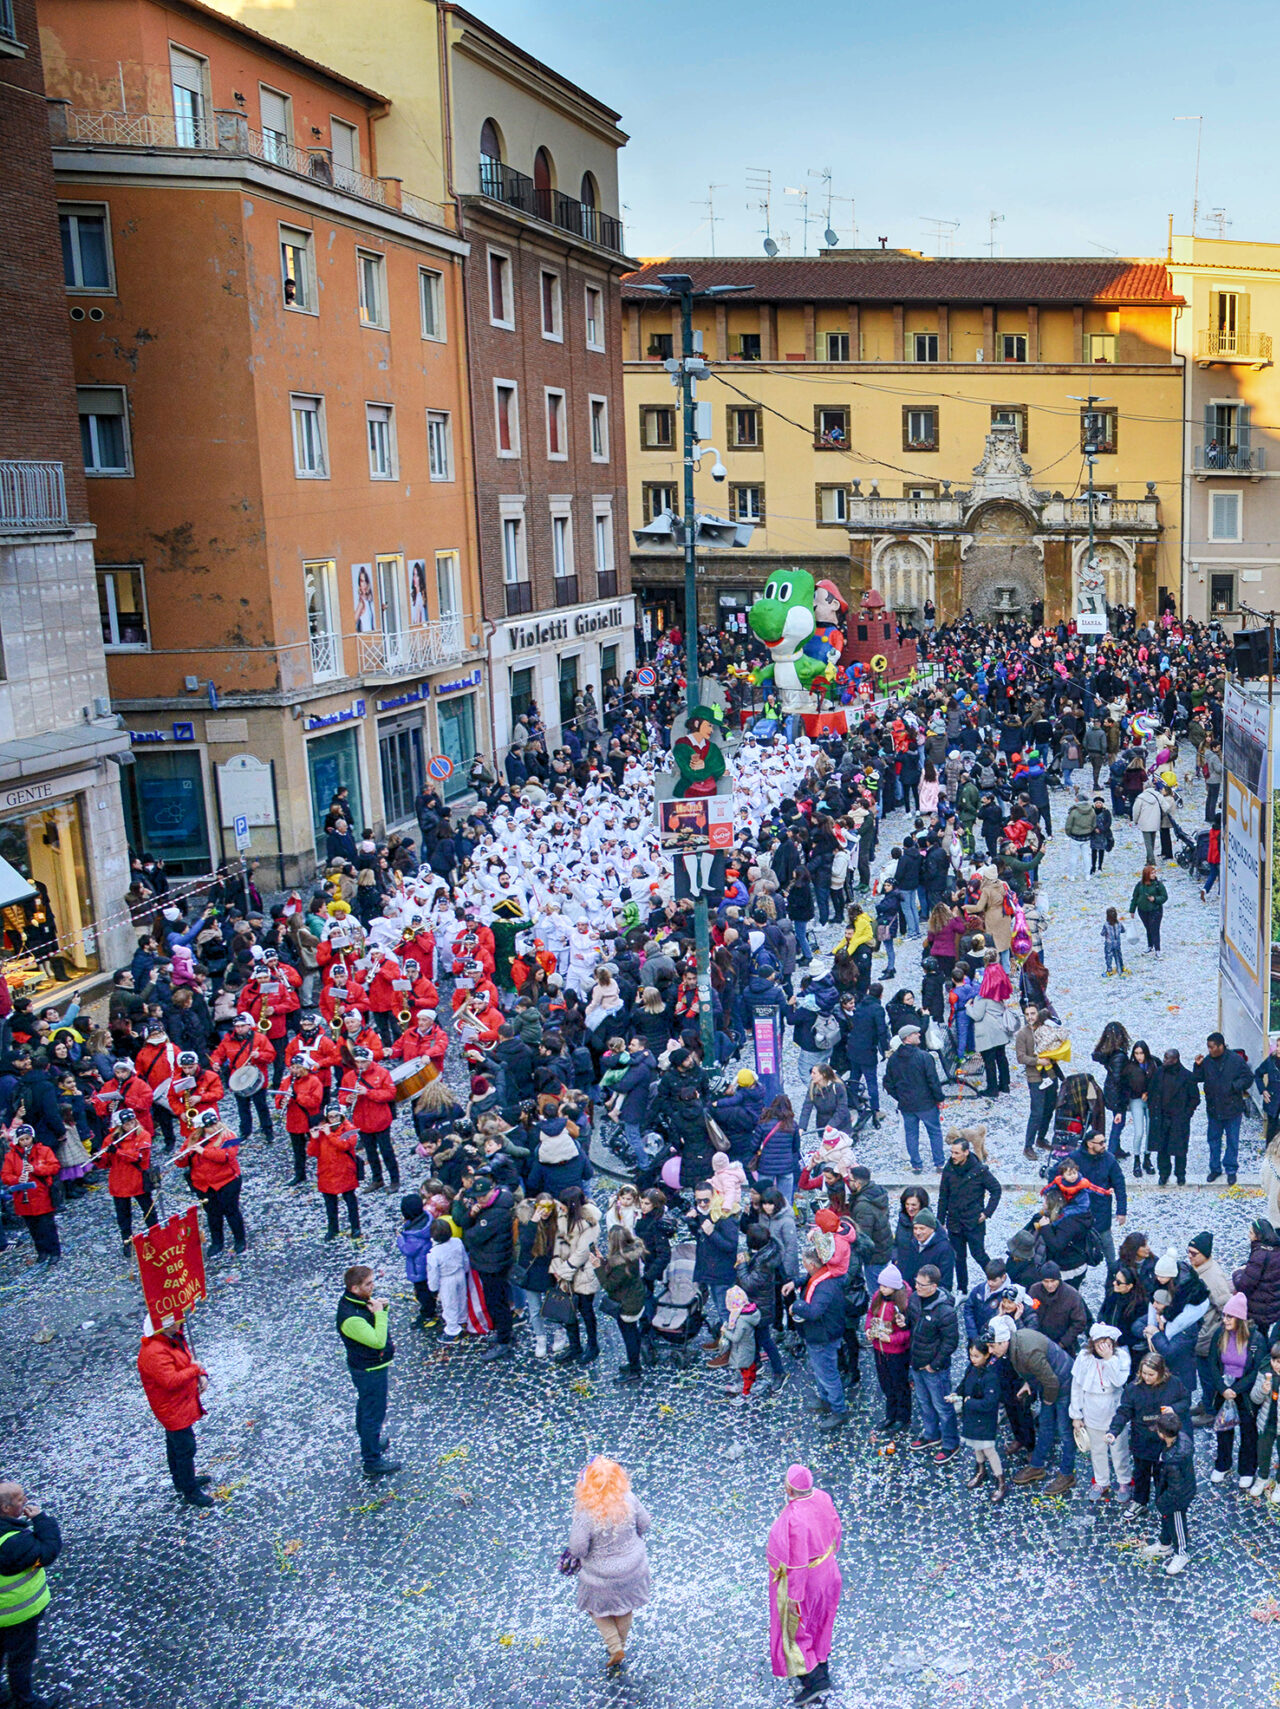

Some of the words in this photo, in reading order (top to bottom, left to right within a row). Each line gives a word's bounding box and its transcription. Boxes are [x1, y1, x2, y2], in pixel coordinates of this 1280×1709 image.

[509, 618, 568, 650] Violetti
[575, 606, 622, 635] Gioielli
[129, 730, 165, 743] Bank
[6, 783, 53, 806] GENTE
[152, 1243, 187, 1268] LITTLE
[166, 1259, 184, 1275] BIG
[163, 1268, 189, 1289] BAND
[155, 1277, 201, 1315] COLONNA
